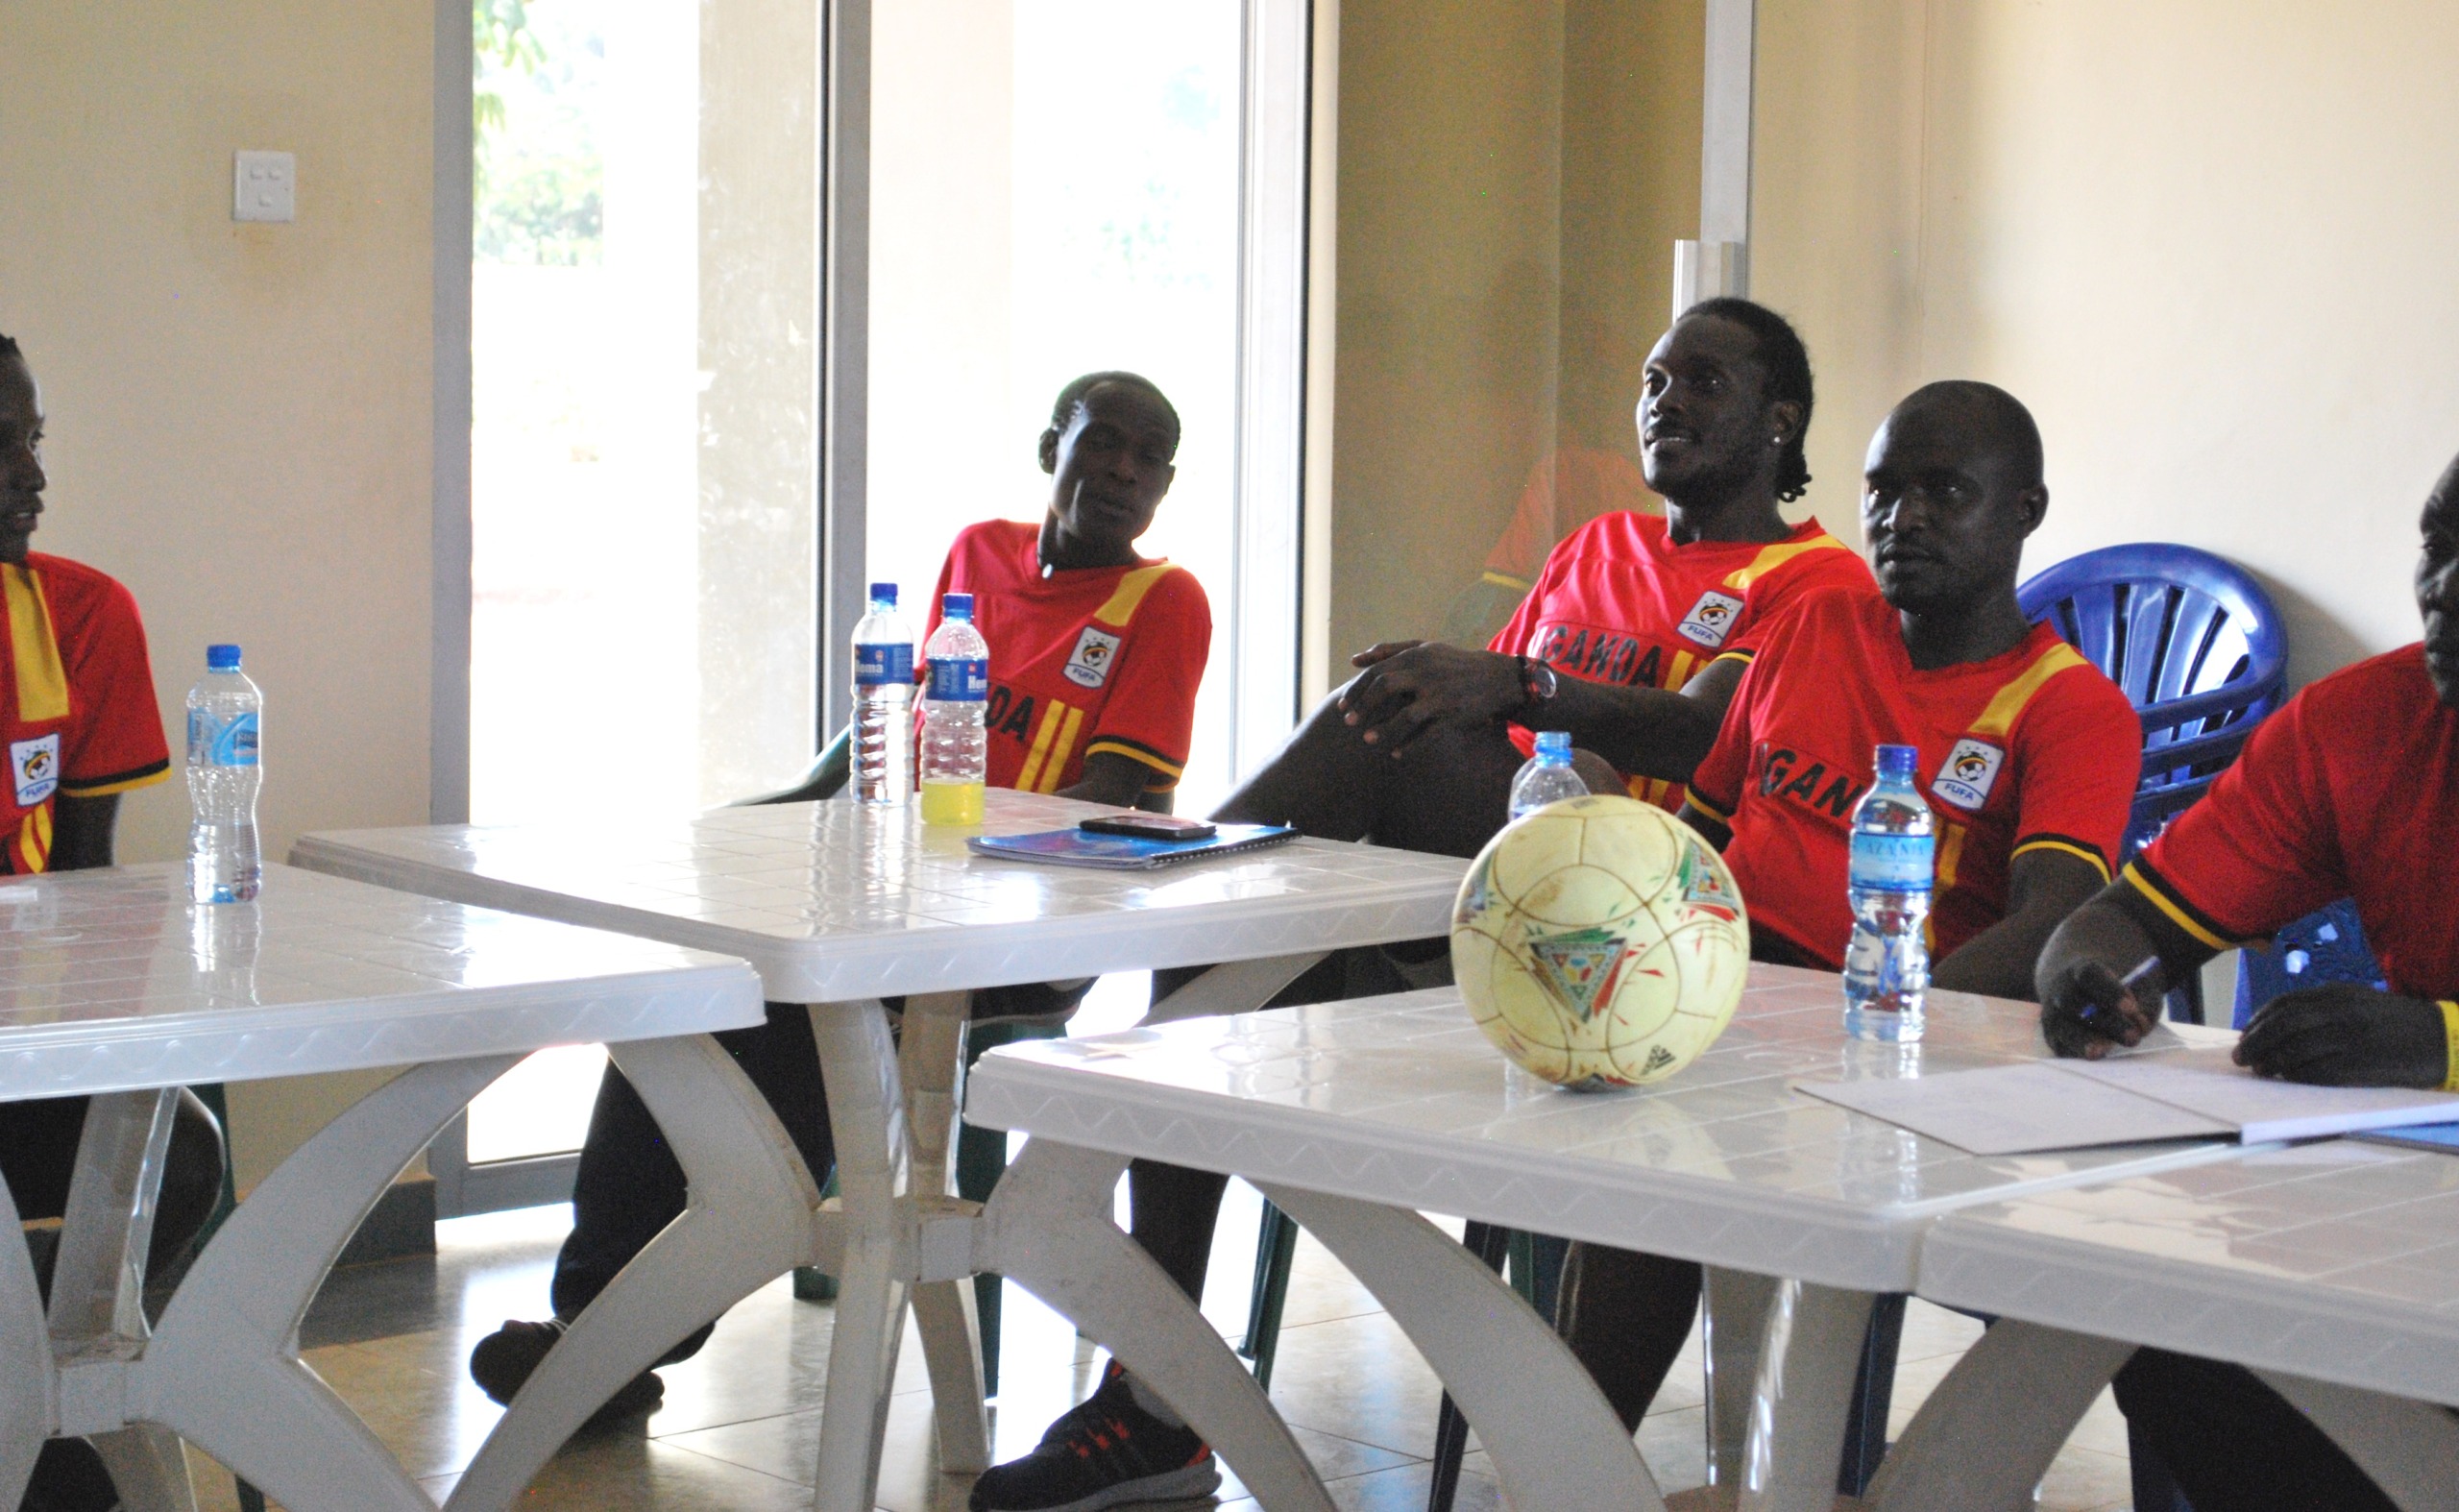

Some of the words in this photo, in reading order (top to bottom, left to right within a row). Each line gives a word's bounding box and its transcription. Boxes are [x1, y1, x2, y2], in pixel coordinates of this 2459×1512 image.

[1688, 624, 1714, 641] FUFA
[1756, 743, 1865, 817] GAN
[1945, 782, 1974, 801] FUFA
